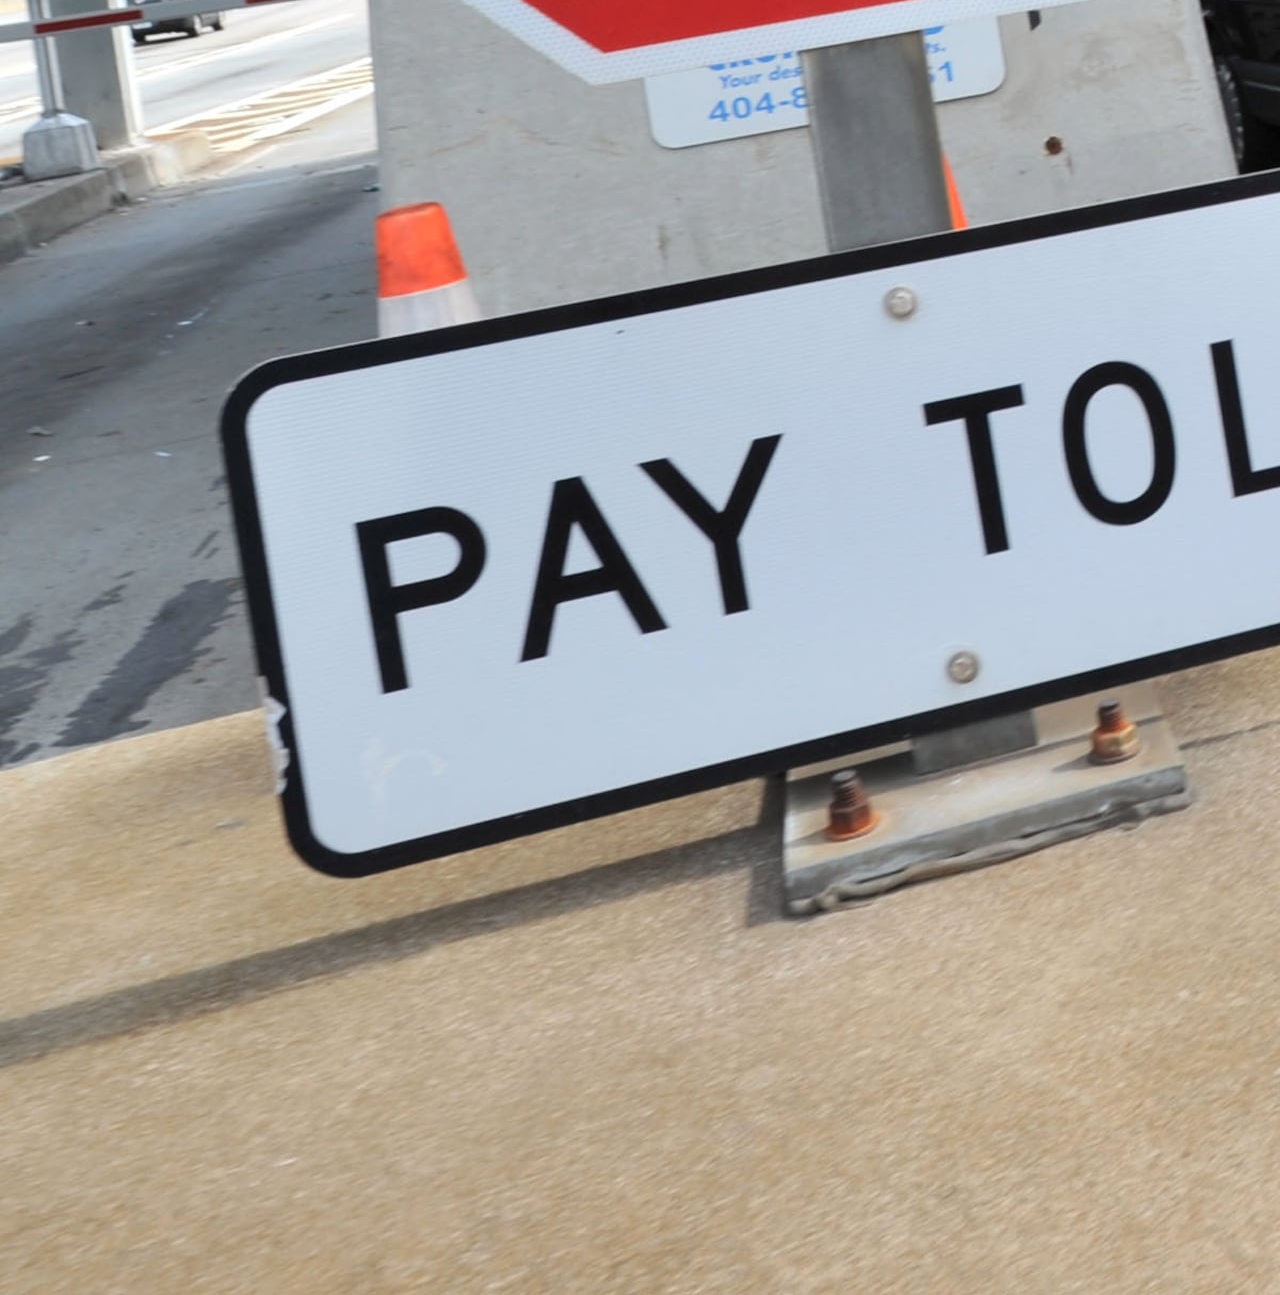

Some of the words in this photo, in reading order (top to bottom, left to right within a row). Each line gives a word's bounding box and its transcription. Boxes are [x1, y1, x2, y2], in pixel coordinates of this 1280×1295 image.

[719, 71, 763, 89] Your
[768, 64, 803, 82] des
[354, 432, 785, 694] PAY
